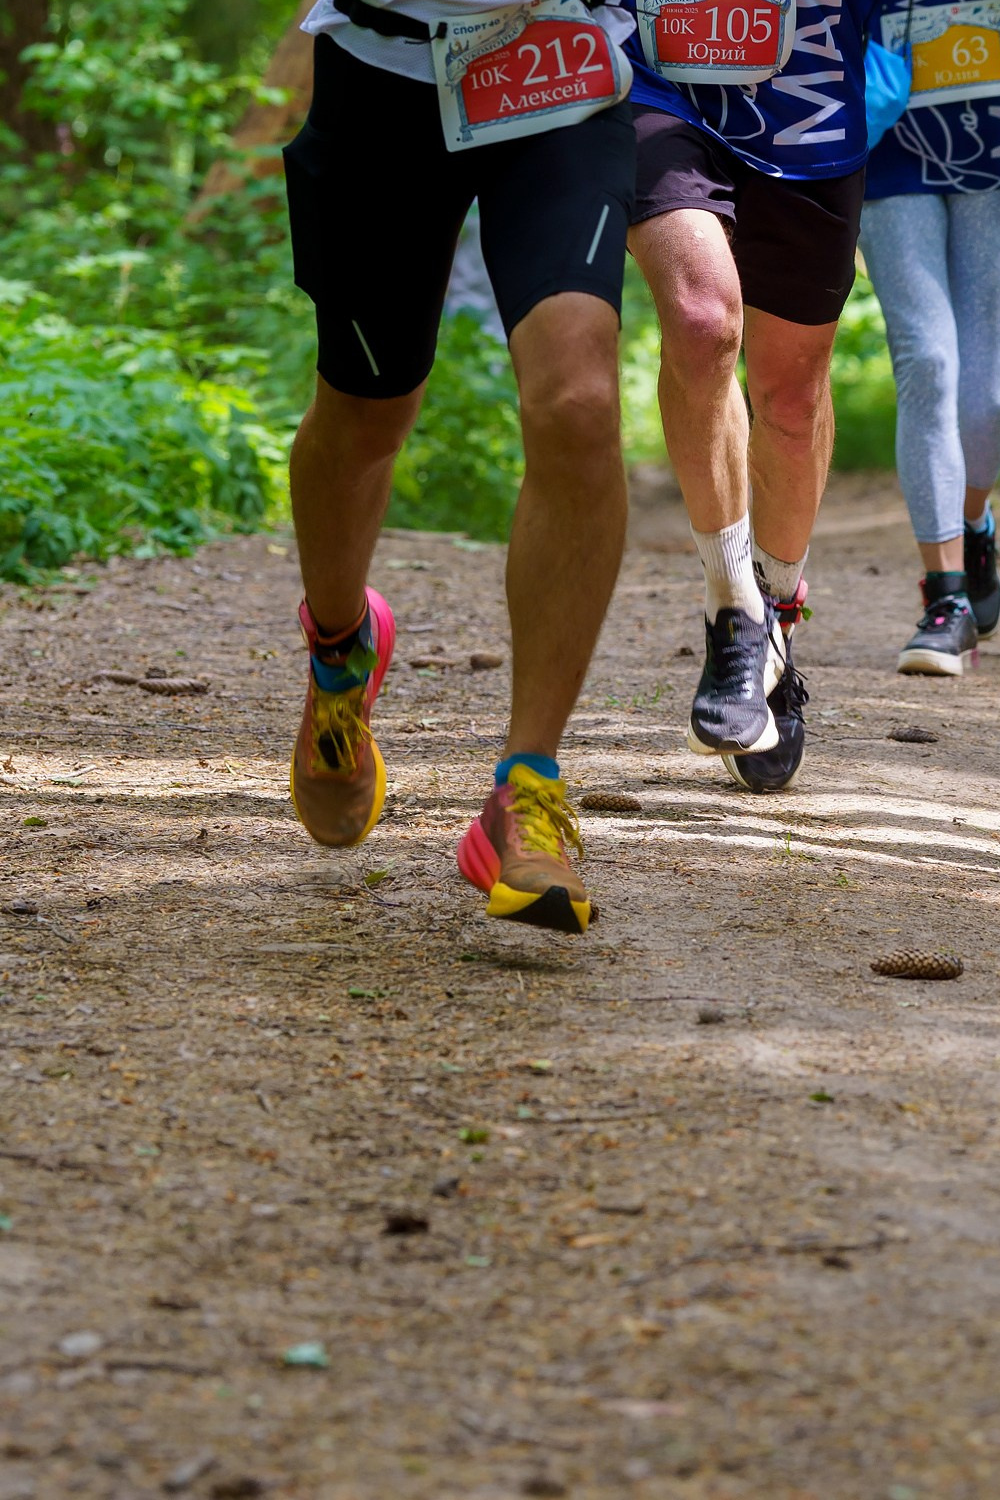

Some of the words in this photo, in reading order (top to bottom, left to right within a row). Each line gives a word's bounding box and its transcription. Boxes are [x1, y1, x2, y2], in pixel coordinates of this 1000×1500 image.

[453, 22, 487, 36] СПОРТ
[488, 18, 501, 28] 40
[705, 6, 772, 43] 105
[517, 33, 603, 85] 212
[687, 43, 746, 64] Юрий
[952, 35, 989, 68] 63
[498, 78, 589, 113] Алексей
